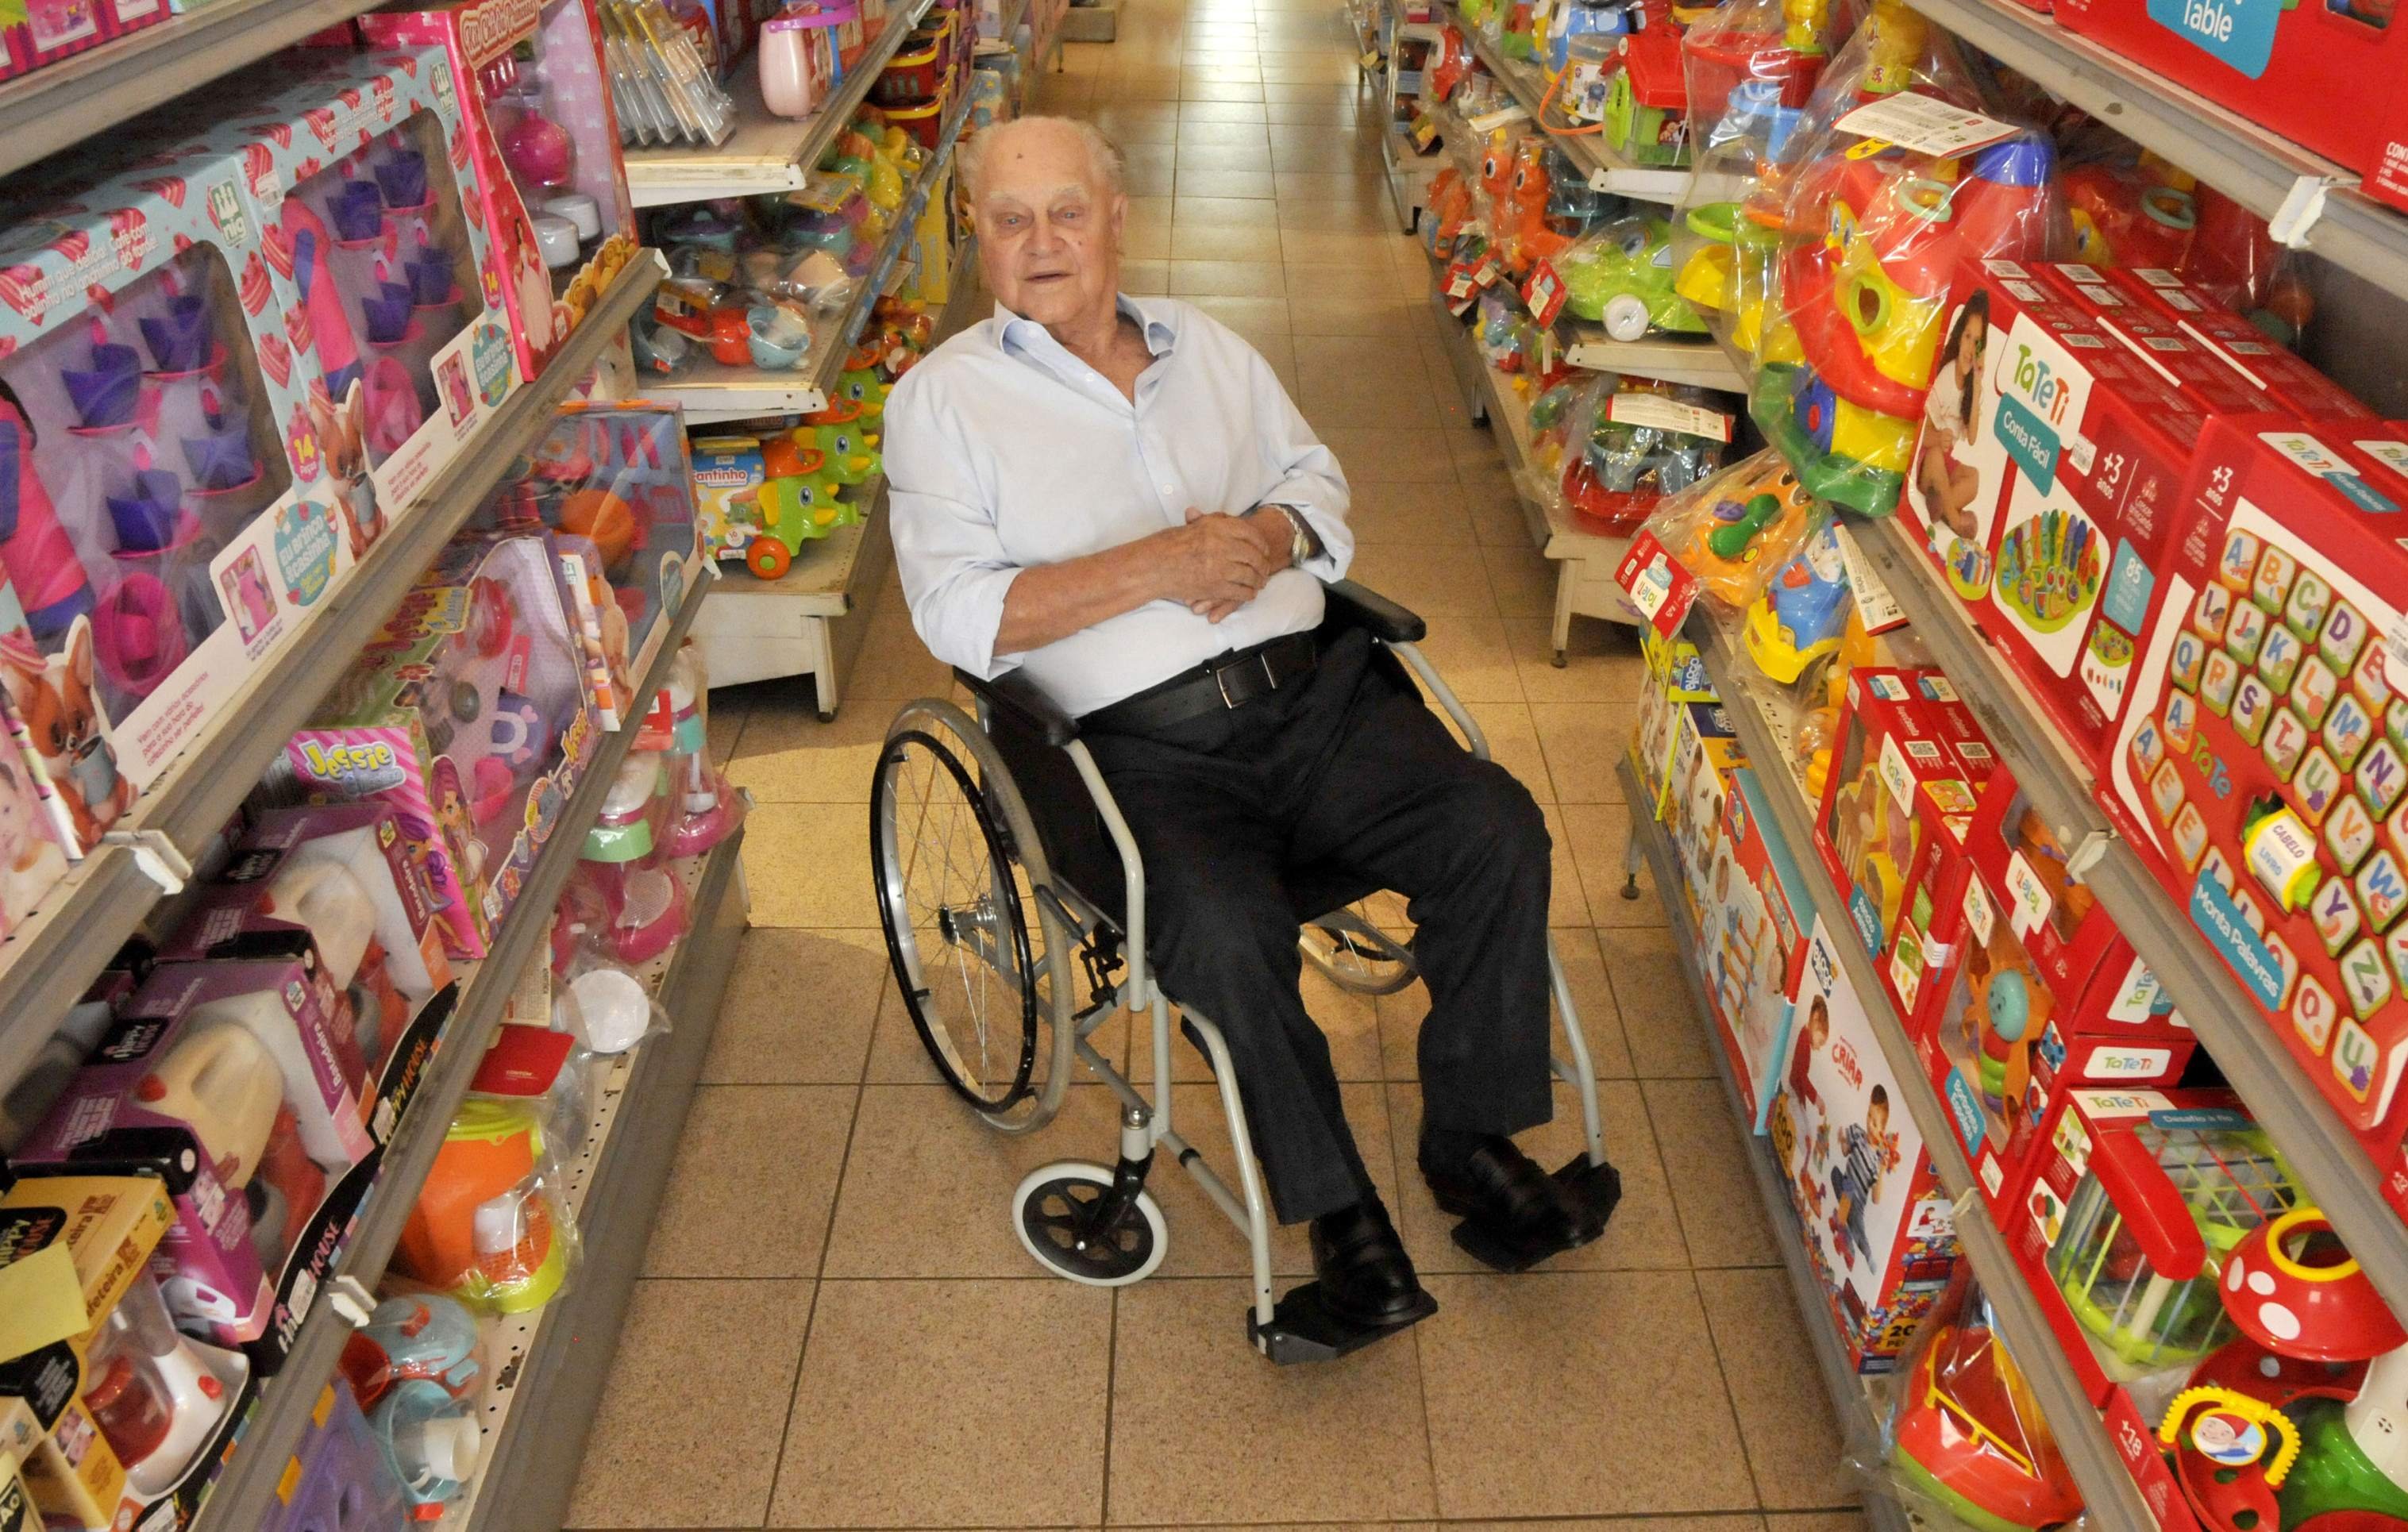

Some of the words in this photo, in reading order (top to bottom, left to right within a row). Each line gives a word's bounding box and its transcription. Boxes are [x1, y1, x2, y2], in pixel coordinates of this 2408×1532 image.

[223, 218, 248, 244] nig
[2014, 344, 2069, 425] TaTeTi
[294, 434, 315, 464] 14
[2003, 410, 2029, 449] Conta
[2028, 437, 2052, 469] Fácil
[2104, 452, 2125, 483] +3
[2212, 465, 2233, 492] +3
[2126, 557, 2143, 584] 85
[2225, 537, 2244, 566] A
[2261, 555, 2282, 584] B
[2296, 580, 2316, 610] C
[2329, 608, 2351, 641] D
[2167, 699, 2183, 729] A
[2235, 610, 2252, 636] J
[2265, 632, 2289, 662] K
[2299, 664, 2317, 699] L
[2331, 702, 2363, 737] M
[2365, 748, 2395, 786] N
[2136, 728, 2153, 753] A
[305, 745, 391, 779] Jessie
[2177, 640, 2194, 675] Q
[2208, 660, 2226, 687] R
[2240, 685, 2259, 715] S
[2275, 717, 2294, 749] T
[2305, 757, 2329, 791] U
[2340, 806, 2364, 842] V
[2368, 858, 2402, 899] W
[2273, 824, 2306, 860] CABELO
[2259, 847, 2283, 877] LIVRO
[2195, 883, 2230, 935] Monta
[2230, 927, 2279, 999] Palavras
[2325, 885, 2349, 918] Y
[2352, 951, 2379, 989] Z
[314, 1022, 341, 1087] Batedeira
[402, 1038, 428, 1095] HOUSE
[1832, 1043, 1863, 1092] CRIAR
[2104, 1056, 2153, 1072] TaTeTi
[2341, 1030, 2367, 1069] U
[2088, 1095, 2151, 1110] TaTeTi
[307, 1219, 341, 1283] HOUSE
